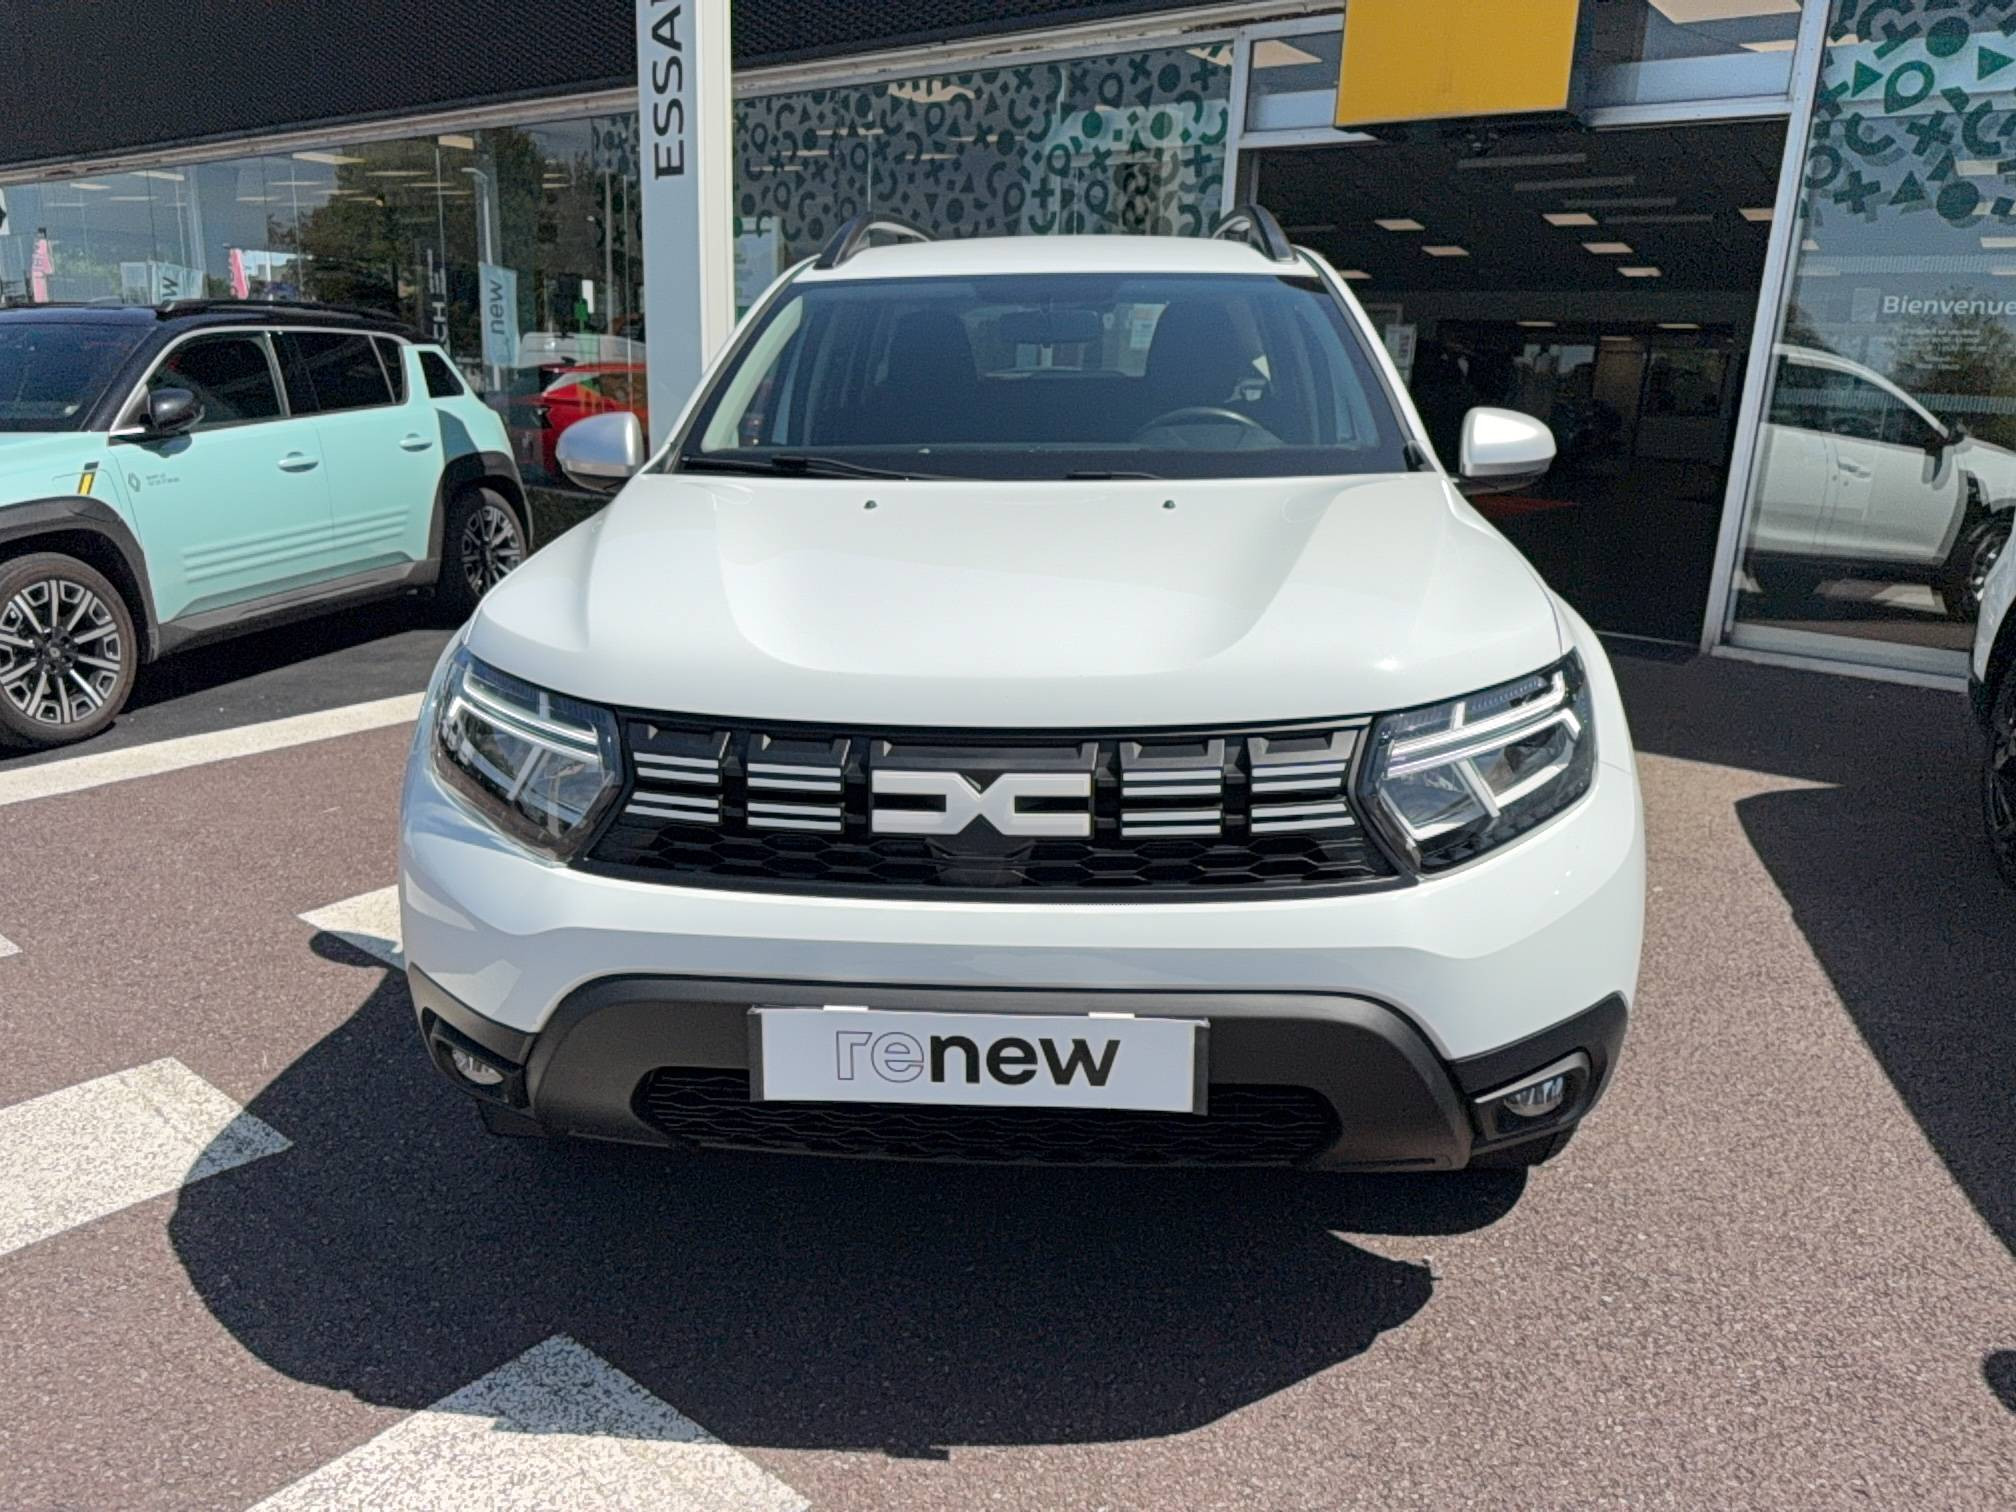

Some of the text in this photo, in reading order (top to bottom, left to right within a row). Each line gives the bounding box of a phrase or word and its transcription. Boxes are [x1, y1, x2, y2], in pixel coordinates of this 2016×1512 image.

[651, 0, 684, 180] ESSA
[1882, 295, 2016, 316] Bienvenue
[836, 1030, 1120, 1087] renew
